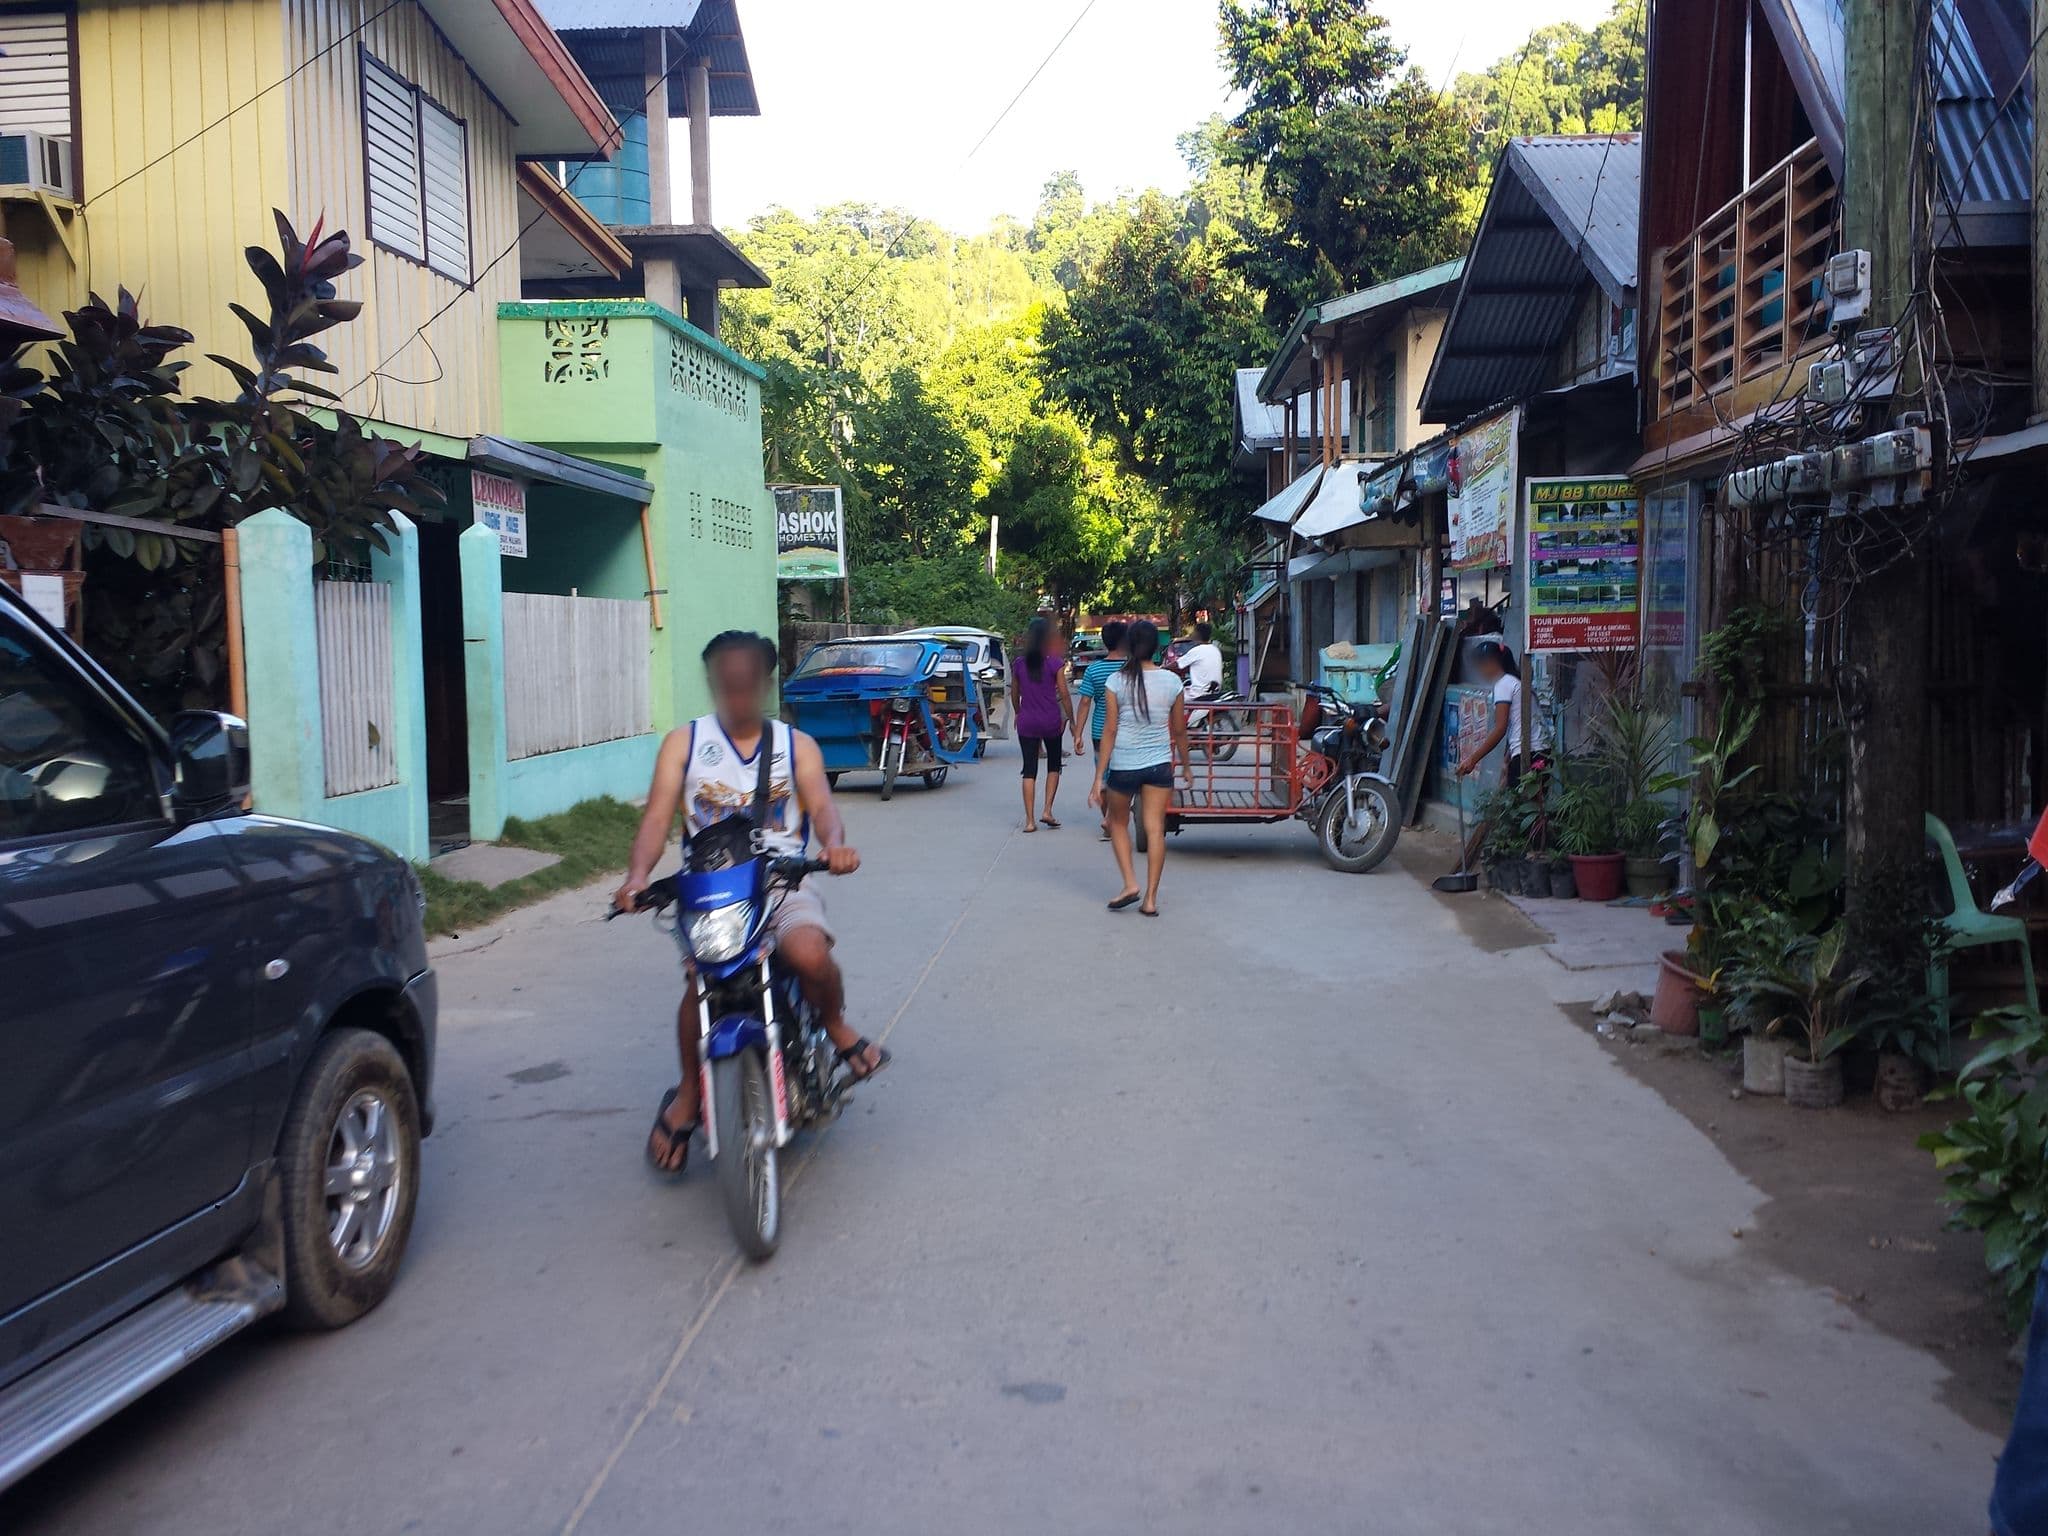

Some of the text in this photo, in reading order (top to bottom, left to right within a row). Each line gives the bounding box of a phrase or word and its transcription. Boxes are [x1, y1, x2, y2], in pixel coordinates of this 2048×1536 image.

[778, 511, 836, 533] ASHOK
[779, 532, 836, 542] HOMESTAY
[1533, 617, 1552, 626] TOUR
